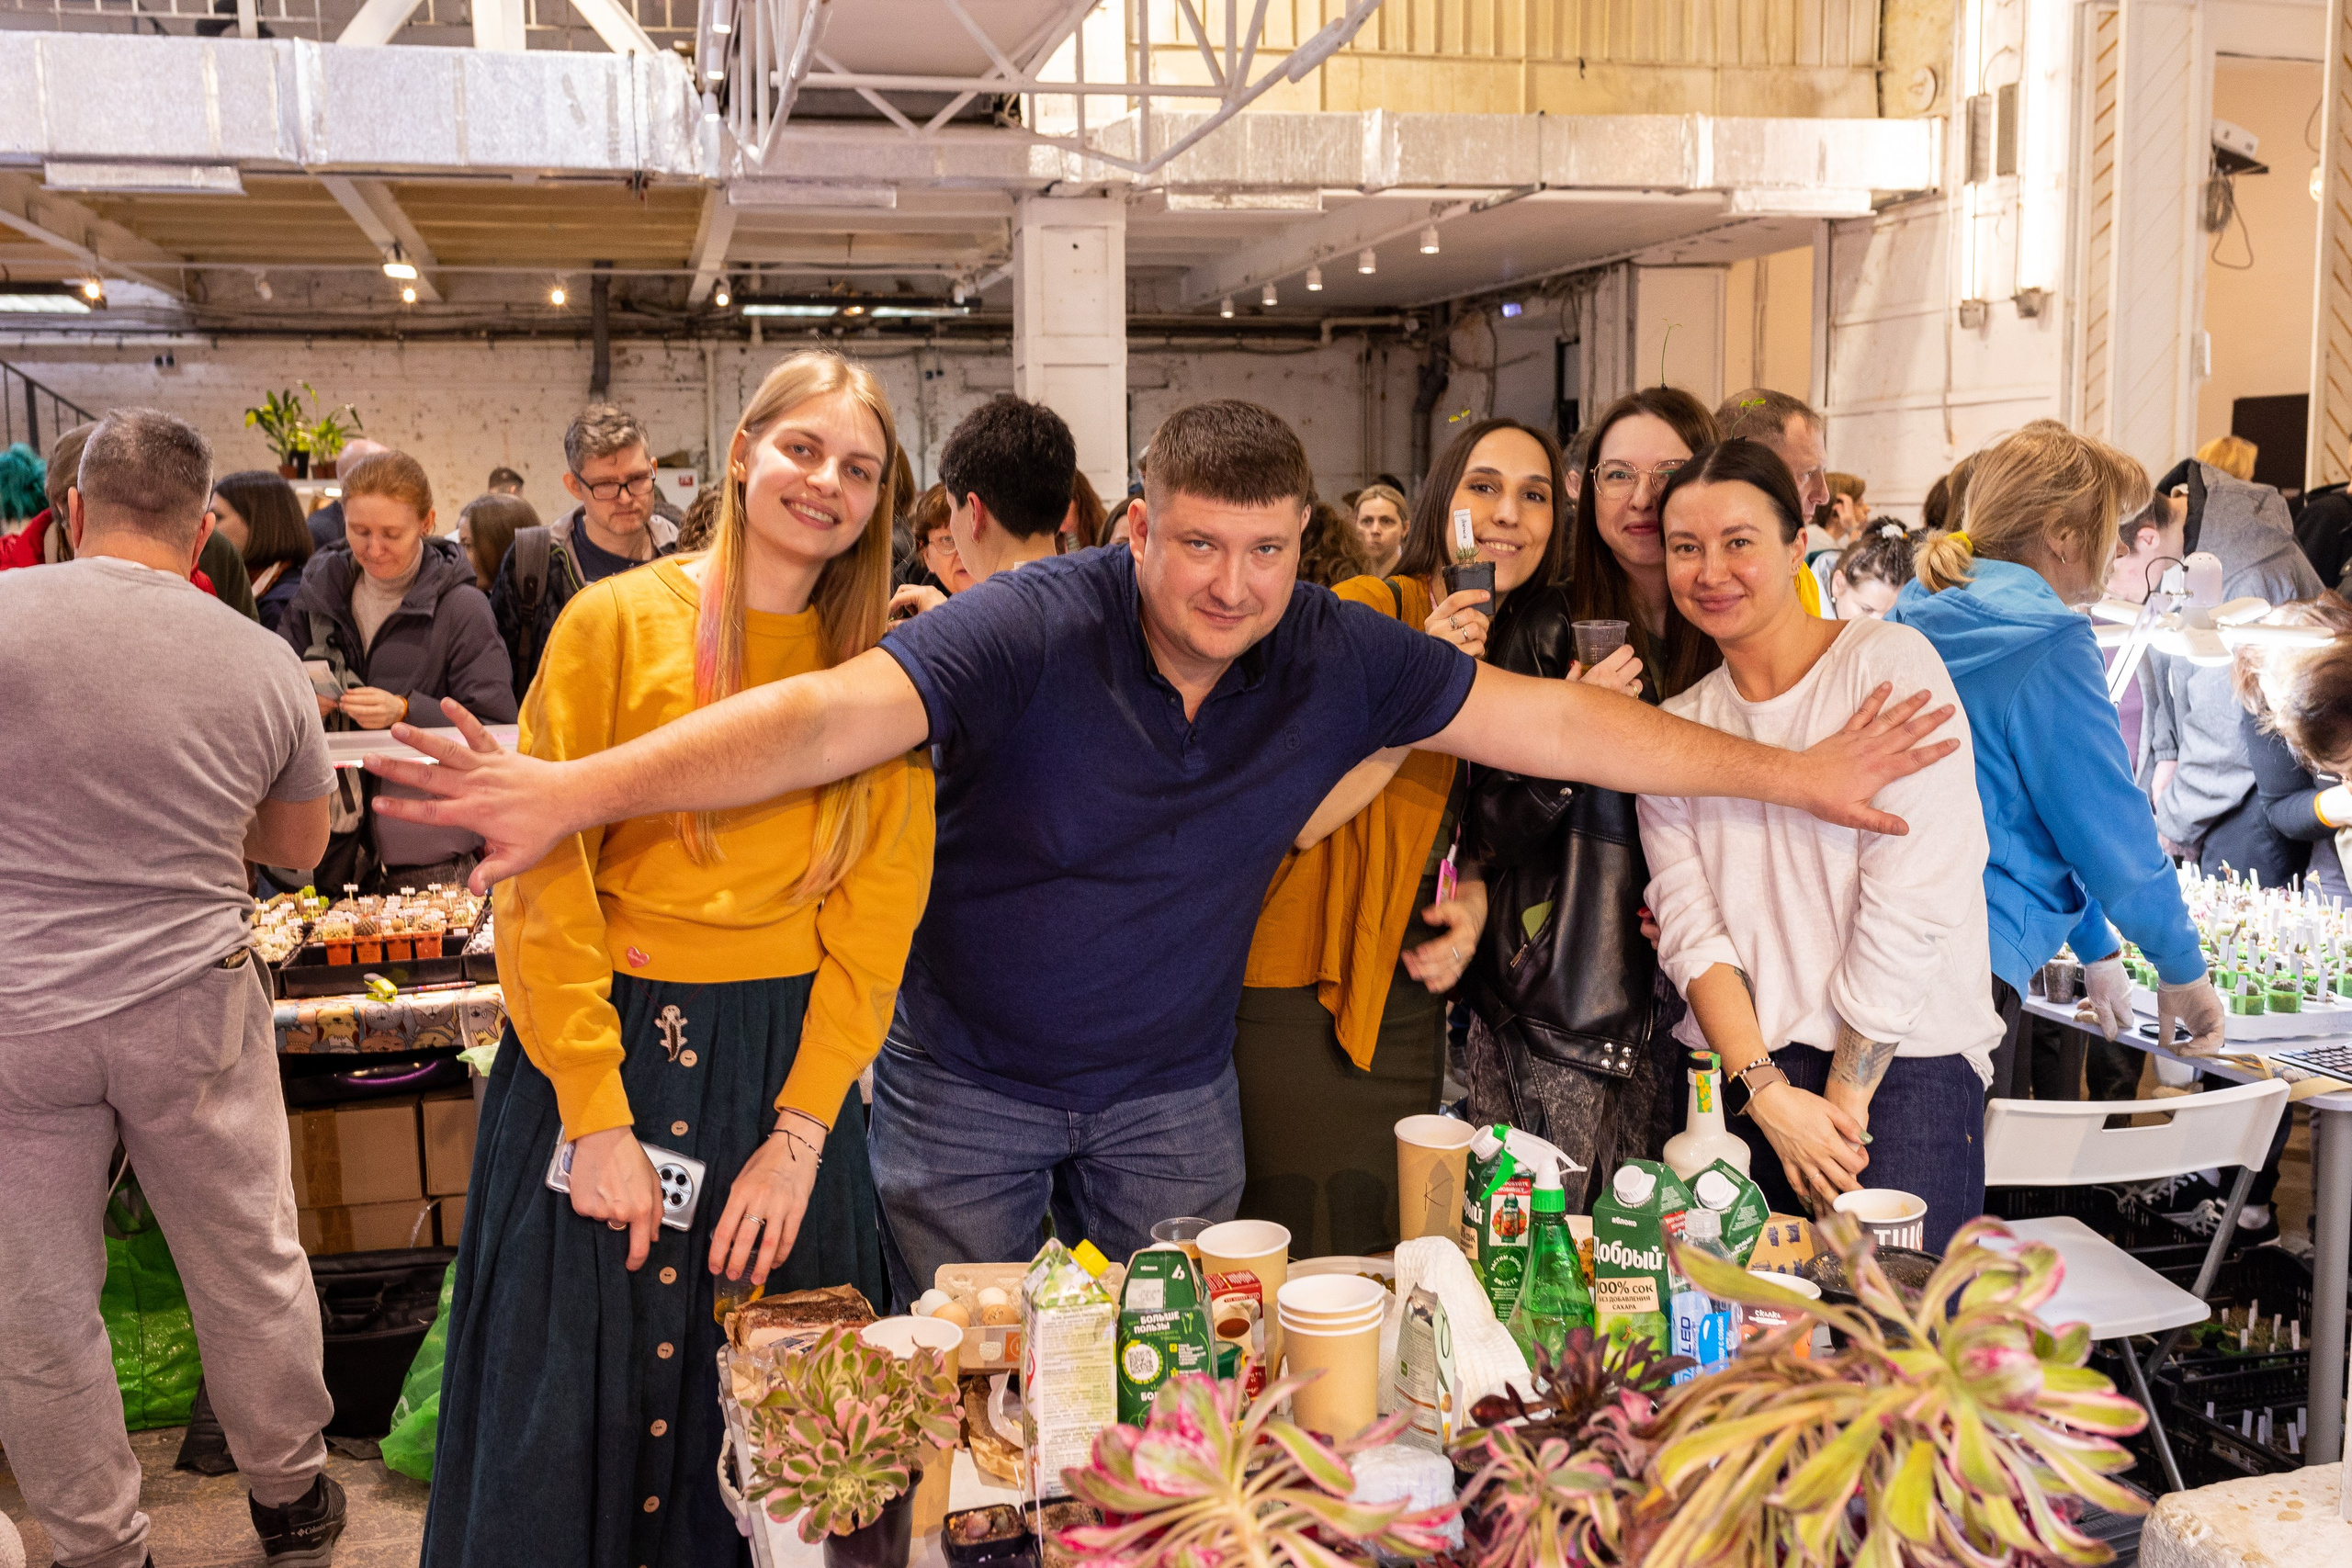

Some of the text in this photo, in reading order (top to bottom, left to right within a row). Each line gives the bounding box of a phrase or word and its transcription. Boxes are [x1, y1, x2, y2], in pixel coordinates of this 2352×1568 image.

[1593, 1235, 1663, 1271] Добрый
[1597, 1280, 1630, 1295] 100%
[1609, 1295, 1651, 1303] ДОБАВЛЕНИЯ
[1140, 1310, 1181, 1325] БОЛЬШЕ
[1133, 1322, 1170, 1335] ПОЛЬЗЫ
